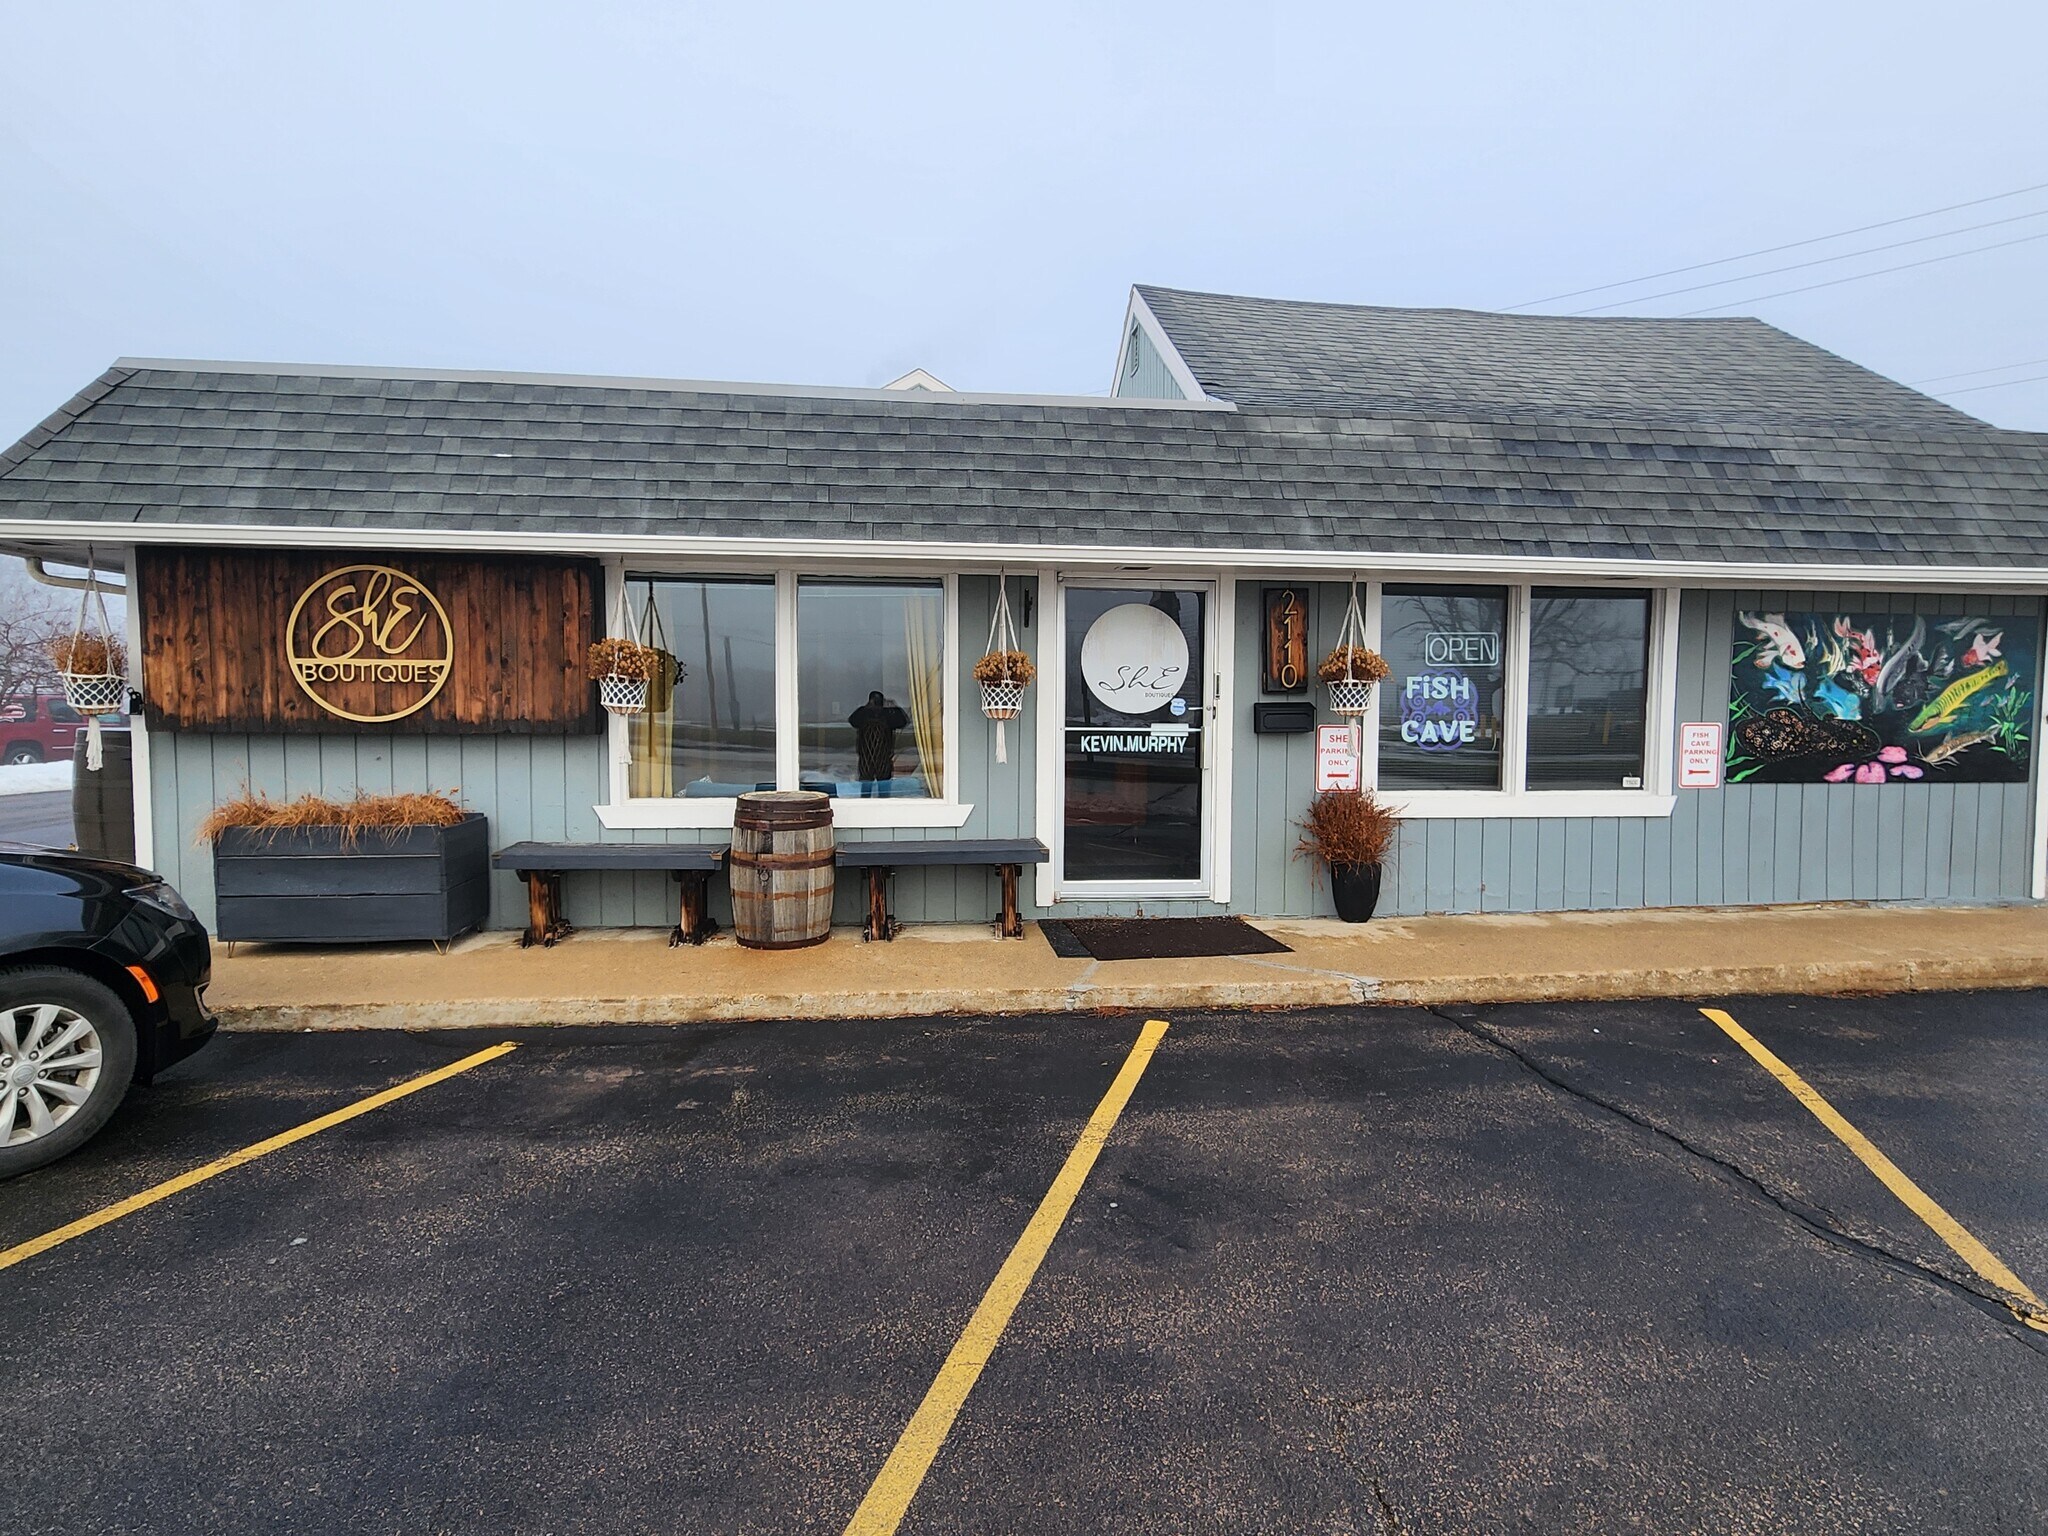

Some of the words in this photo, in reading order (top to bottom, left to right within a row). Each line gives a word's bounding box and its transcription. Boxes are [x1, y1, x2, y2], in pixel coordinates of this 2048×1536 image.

[1281, 590, 1298, 688] 2110
[1429, 637, 1496, 661] OPEN
[302, 662, 442, 683] BOUTIQUES
[1329, 734, 1349, 743] SHE
[1401, 720, 1476, 742] CAVE
[1080, 735, 1187, 753] KEVIN.MURPHY
